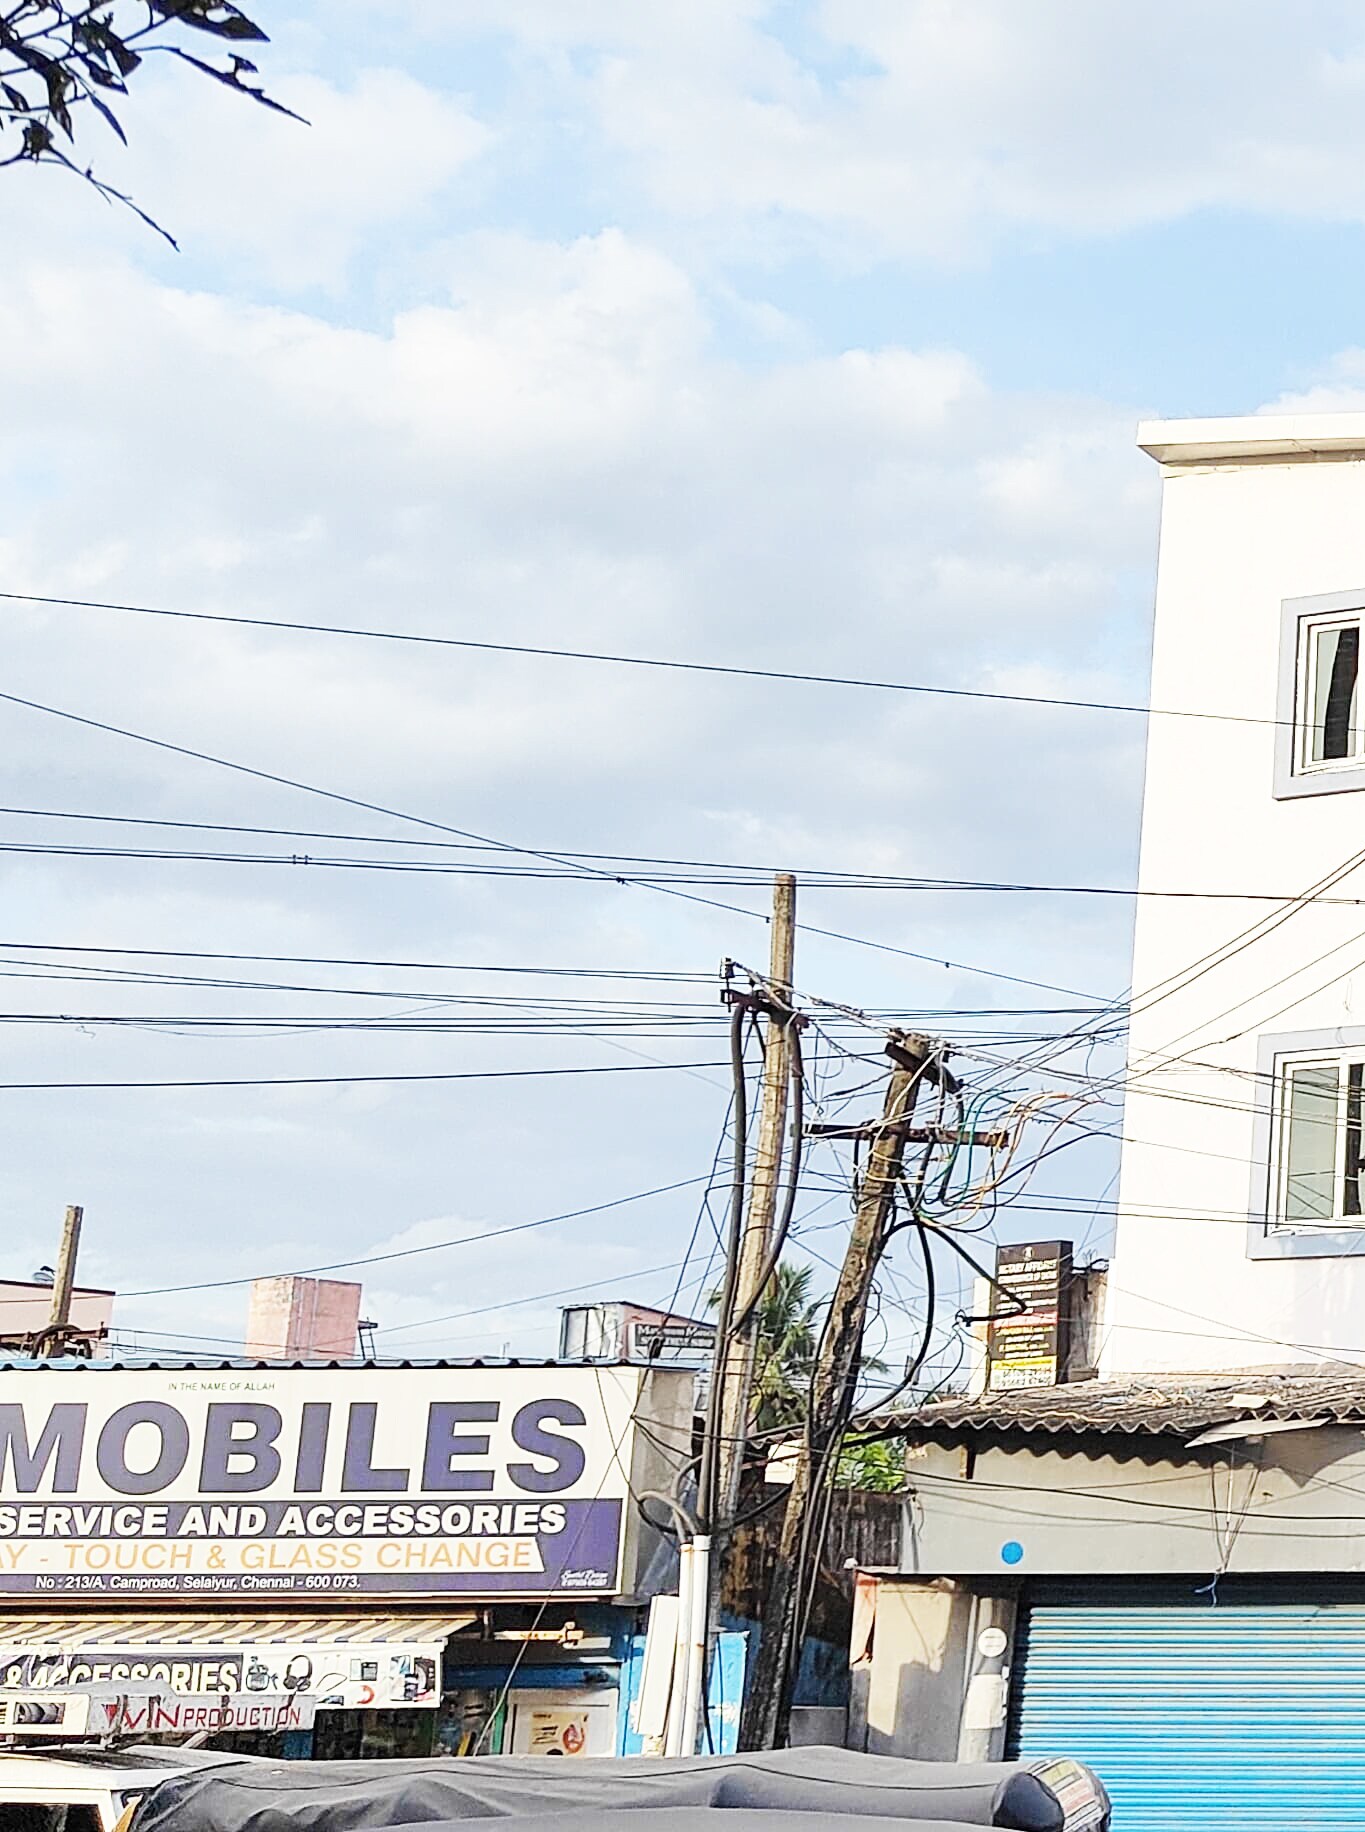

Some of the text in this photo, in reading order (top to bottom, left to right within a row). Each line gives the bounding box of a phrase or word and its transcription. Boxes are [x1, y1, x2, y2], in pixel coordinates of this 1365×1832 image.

[168, 1382, 275, 1391] IN THE NAME OF ALLAH
[0, 1399, 588, 1495] MOBILES
[0, 1502, 567, 1538] SERVICE AND ACCESSORIES
[64, 1543, 193, 1569] TOUCH
[206, 1543, 227, 1569] &
[240, 1542, 363, 1570] GLASS
[376, 1541, 533, 1568] CHANGE
[35, 1576, 55, 1589] No
[64, 1576, 107, 1590] 213/A,
[110, 1575, 179, 1591] Camproad,
[241, 1575, 295, 1589] Chennai
[305, 1576, 331, 1588] 600
[332, 1576, 361, 1588] 073.
[183, 1704, 301, 1729] PRODUCTION
